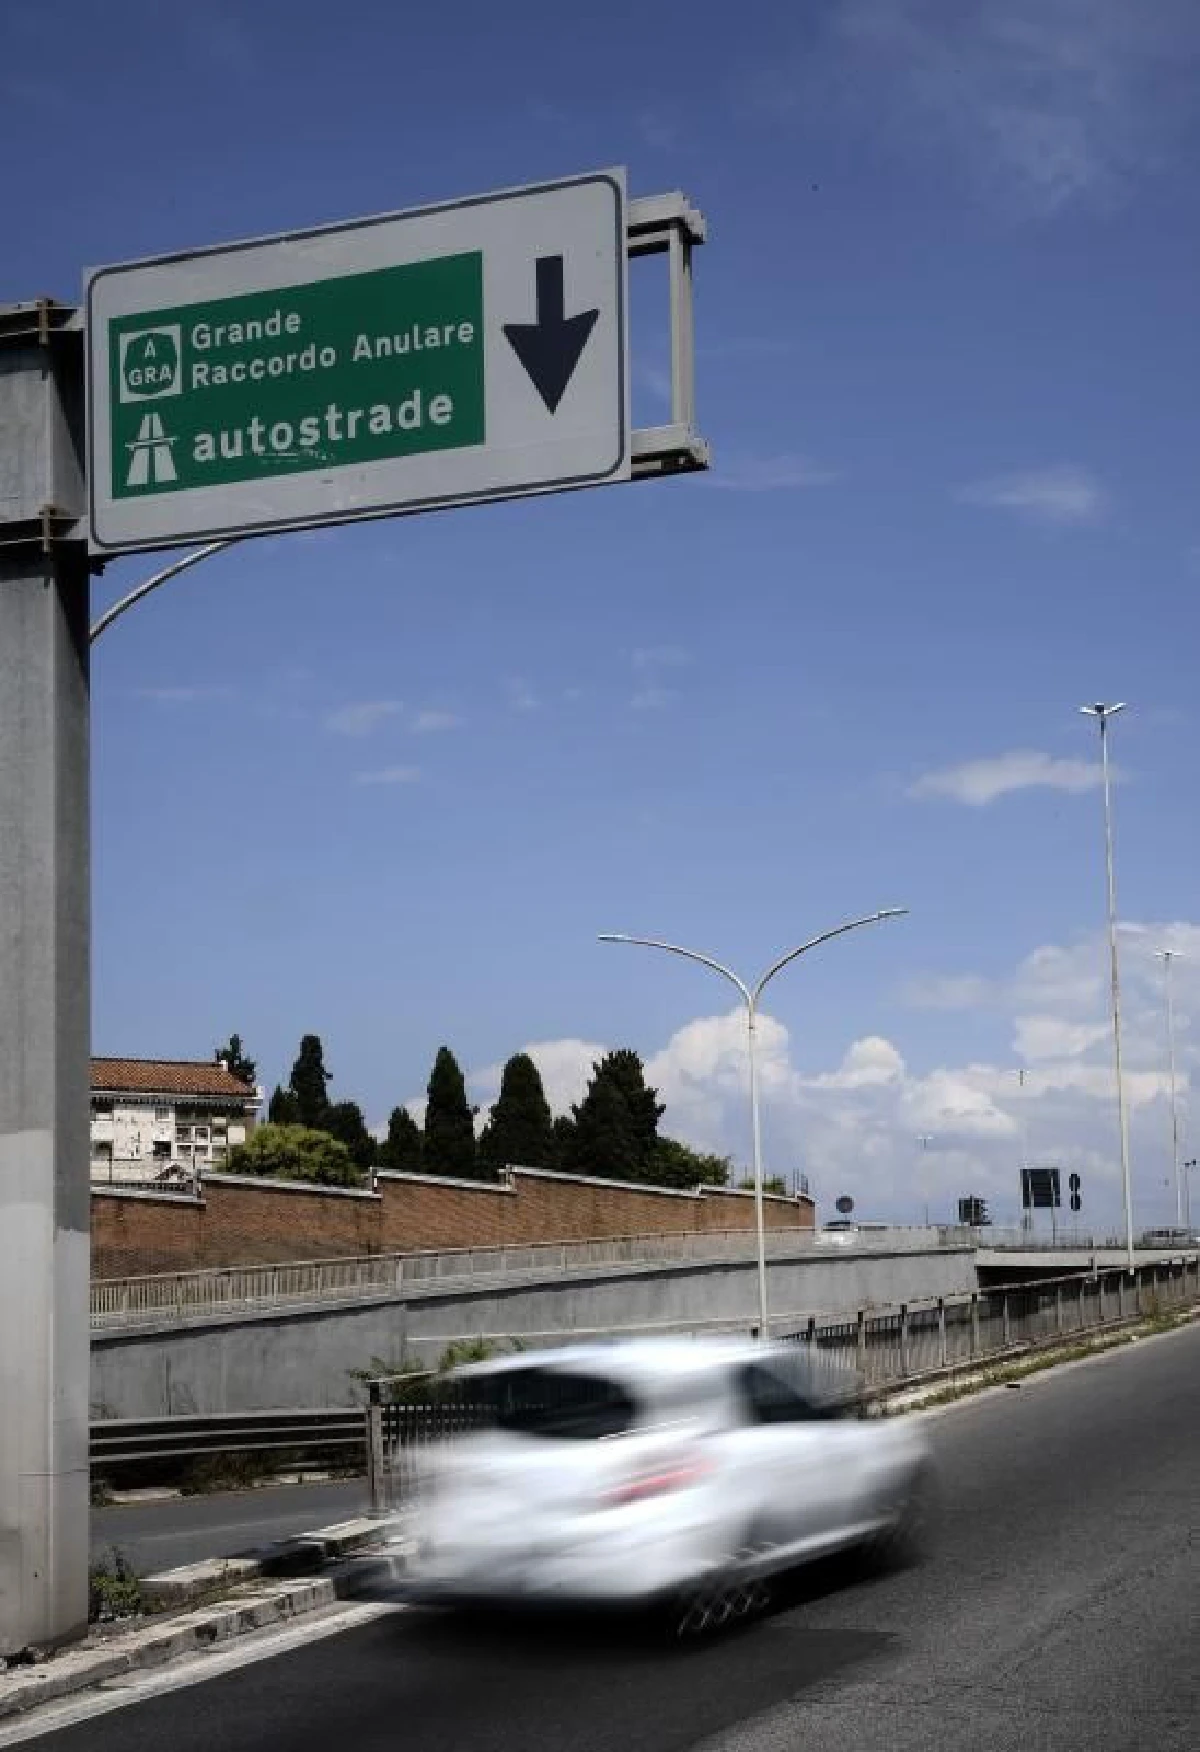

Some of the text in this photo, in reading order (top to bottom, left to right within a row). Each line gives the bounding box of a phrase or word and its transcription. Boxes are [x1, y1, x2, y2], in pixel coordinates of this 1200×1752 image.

[144, 338, 156, 358] A
[192, 310, 300, 350] Grande
[192, 321, 474, 389] Raccordo Anulare
[128, 366, 173, 387] GRA
[193, 389, 454, 462] autostrade
